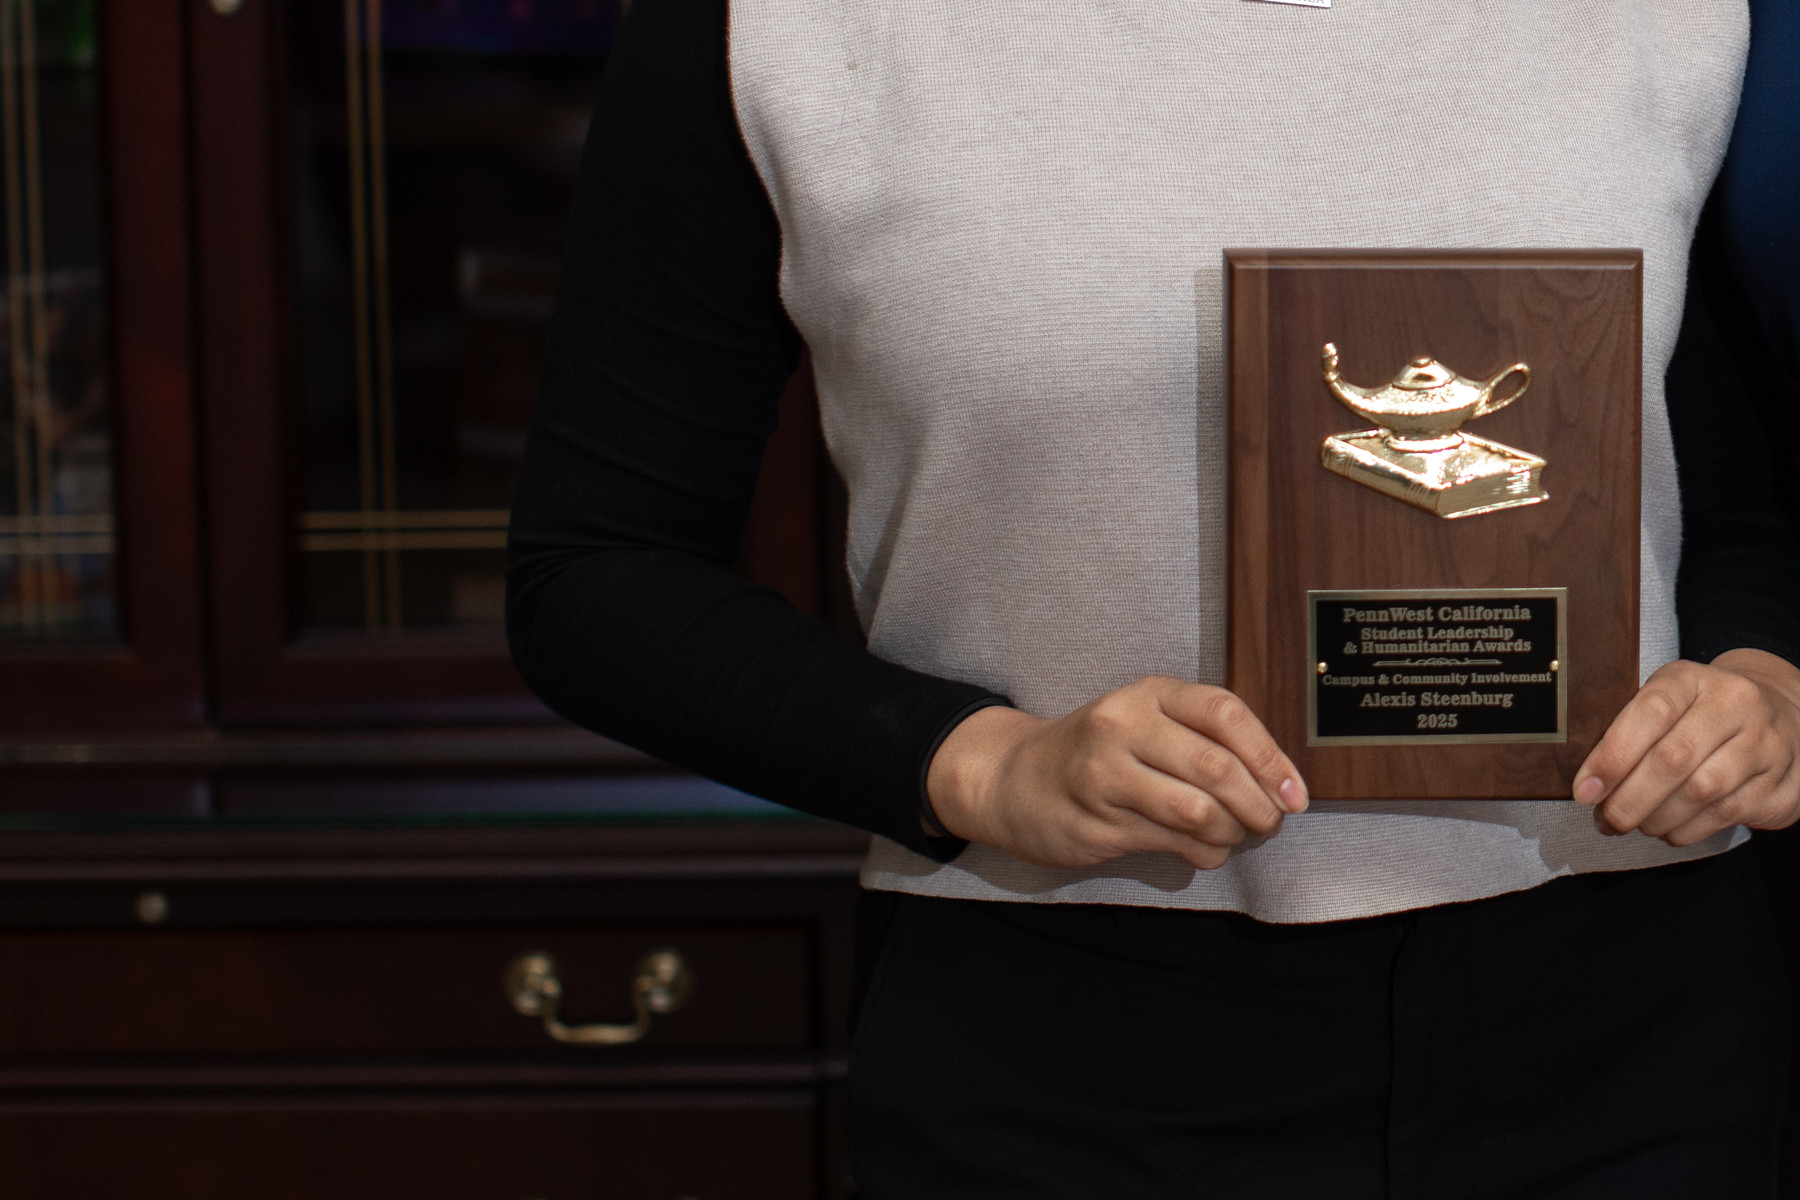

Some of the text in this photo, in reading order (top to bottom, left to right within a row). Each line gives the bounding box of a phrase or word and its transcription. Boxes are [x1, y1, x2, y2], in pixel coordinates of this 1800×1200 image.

[1343, 605, 1532, 623] PennWest California
[1360, 625, 1514, 641] Student Leadership
[1343, 638, 1532, 654] & Humanitarian Awards
[1321, 671, 1552, 687] Campus & Community Involvement
[1360, 691, 1514, 708] Alexis Steenburg
[1416, 713, 1458, 728] 2025
